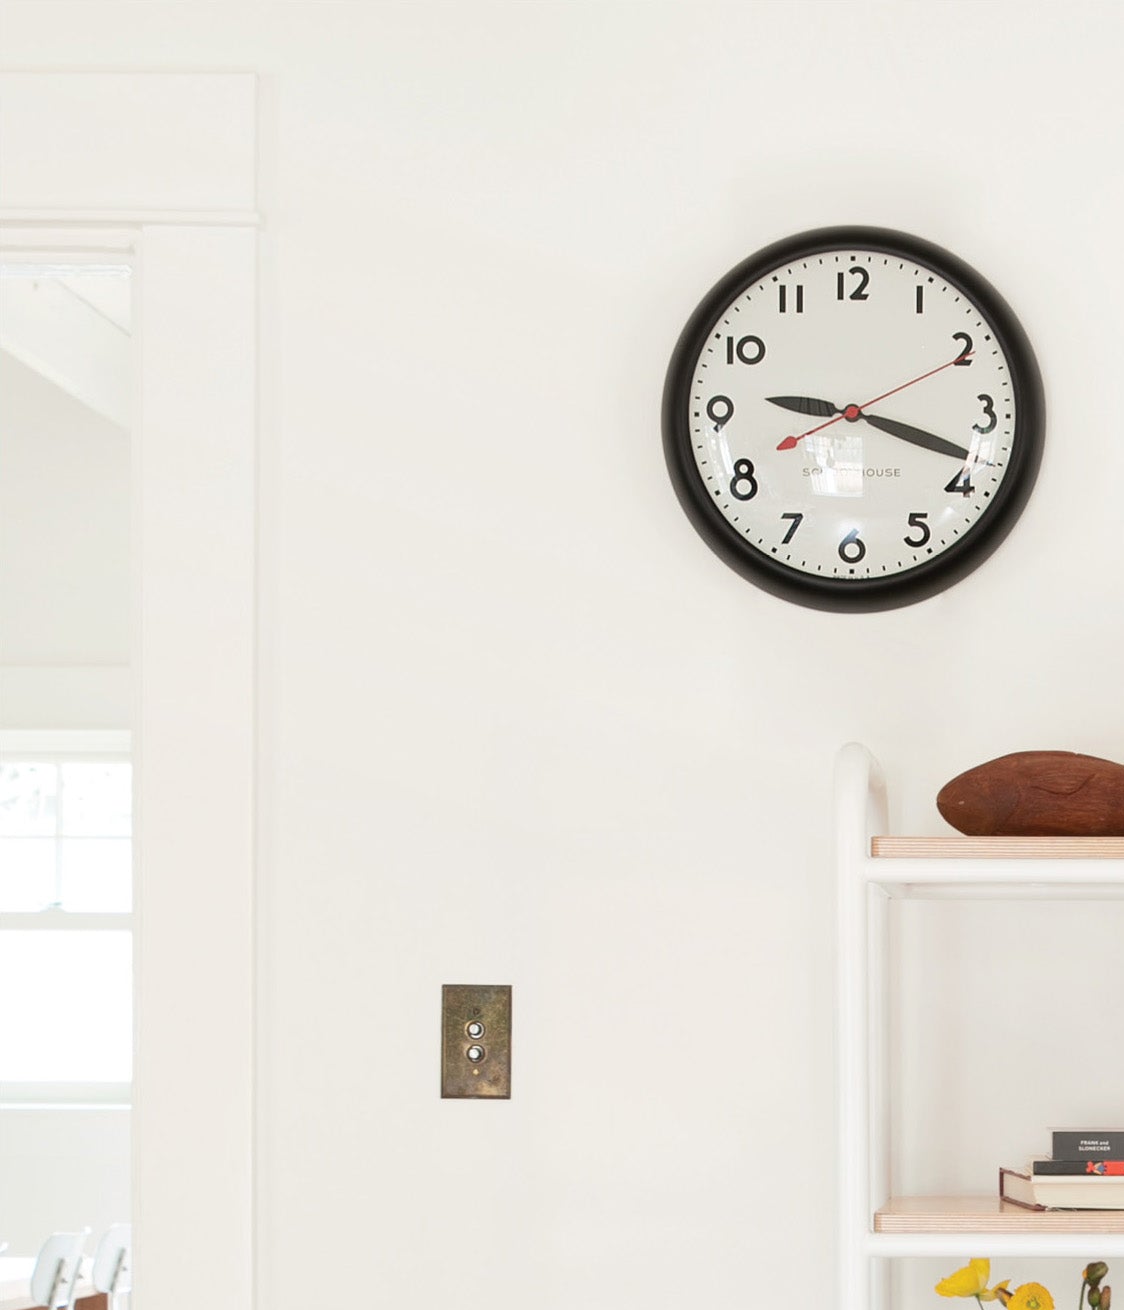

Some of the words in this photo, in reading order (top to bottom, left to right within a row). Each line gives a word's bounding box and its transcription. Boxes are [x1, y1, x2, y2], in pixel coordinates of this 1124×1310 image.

[779, 285, 803, 313] 11
[836, 266, 870, 300] 12
[916, 285, 924, 314] 1
[726, 335, 766, 365] 10
[952, 332, 973, 366] 2
[706, 395, 735, 433] 9
[972, 394, 998, 434] 3
[729, 458, 758, 502] 8
[944, 464, 975, 498] 4
[780, 512, 804, 544] 7
[903, 512, 932, 548] 5
[838, 528, 867, 563] 6
